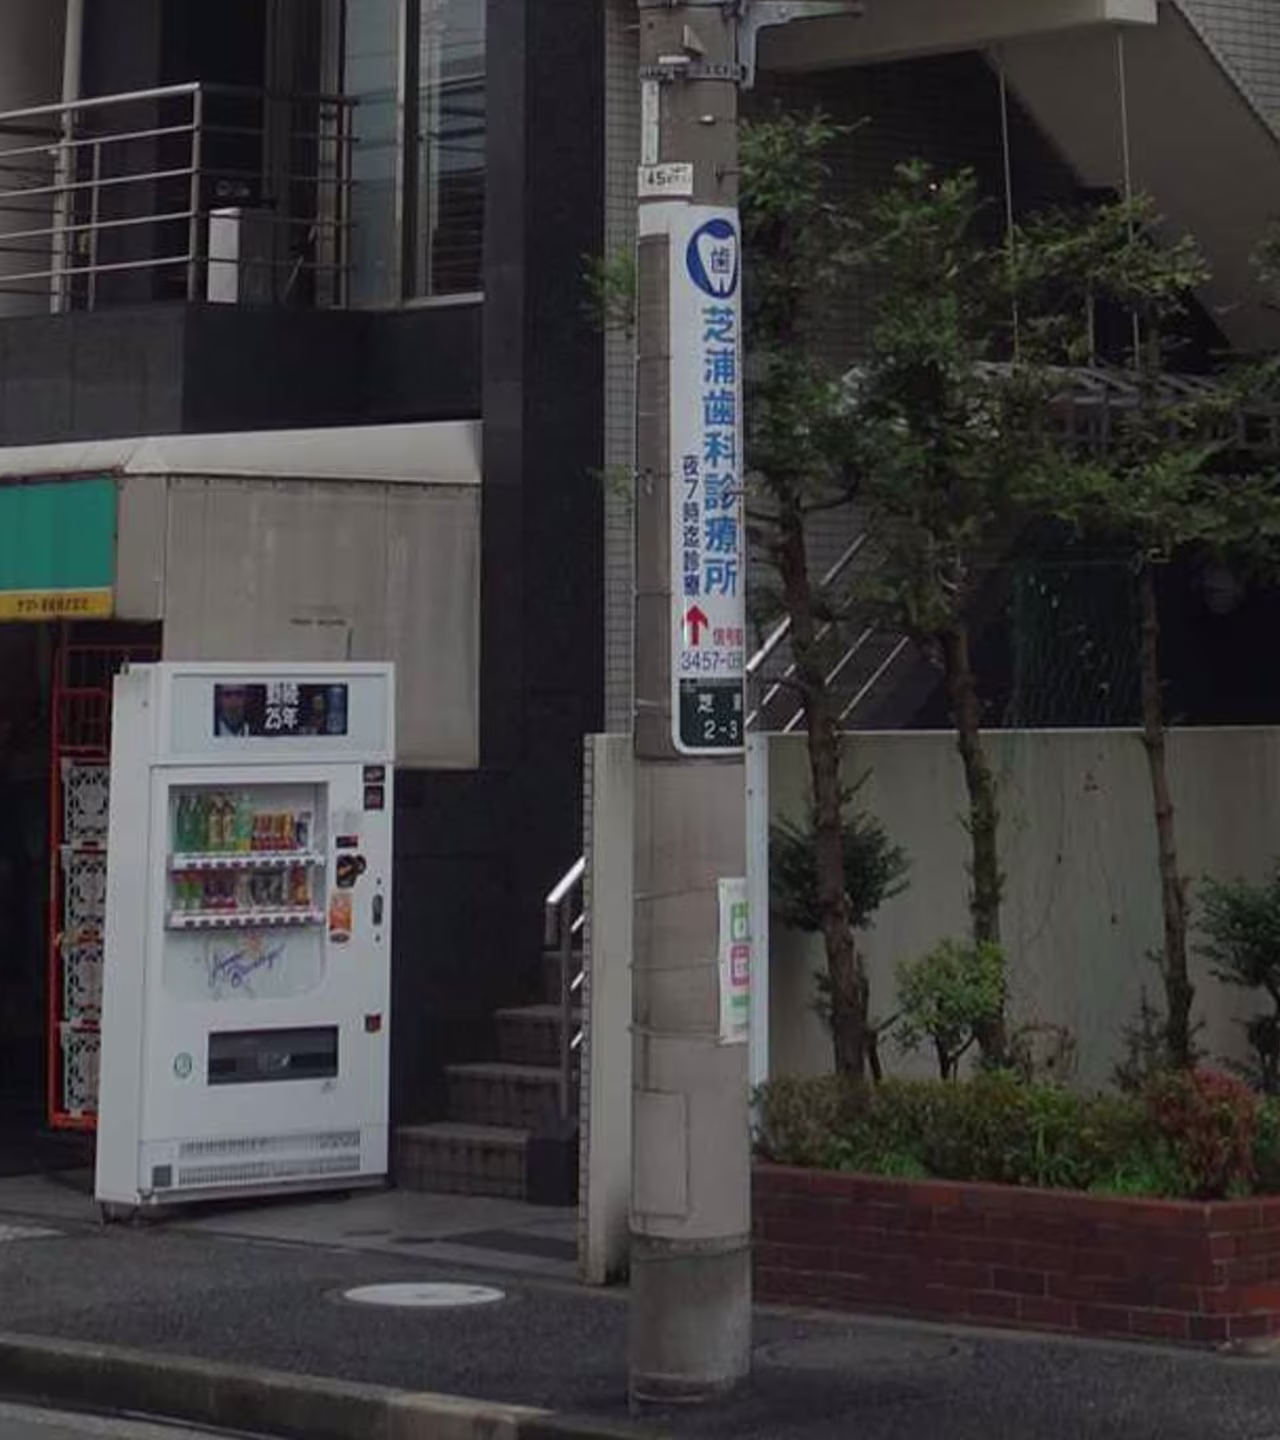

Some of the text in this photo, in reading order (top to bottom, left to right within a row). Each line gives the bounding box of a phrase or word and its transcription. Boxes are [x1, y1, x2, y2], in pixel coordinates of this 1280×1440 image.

[702, 305, 737, 597] 芝浦歯科診療所
